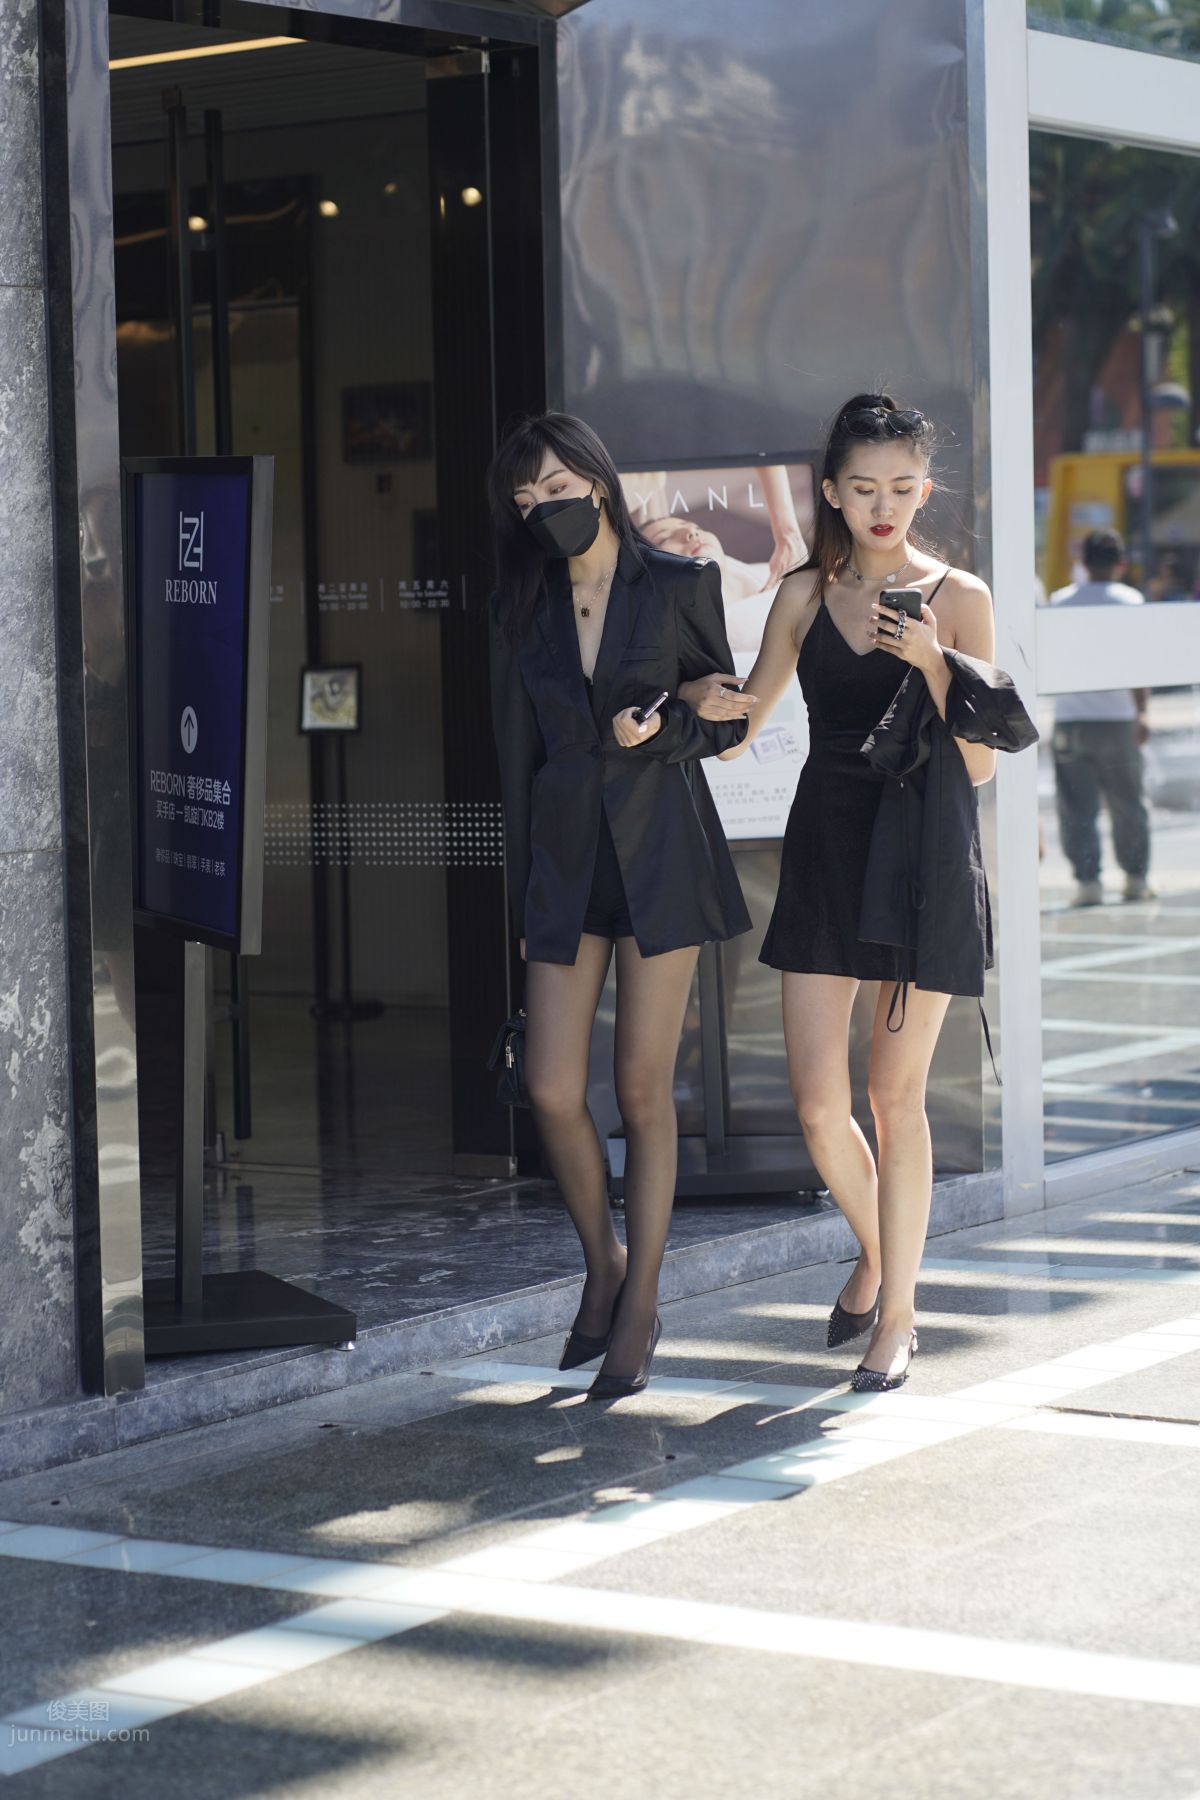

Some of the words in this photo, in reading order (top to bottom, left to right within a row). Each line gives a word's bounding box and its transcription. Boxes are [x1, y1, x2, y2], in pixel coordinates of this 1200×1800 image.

[165, 579, 217, 604] REBORN
[150, 770, 186, 797] REBORN
[186, 775, 232, 805] 奢侈品集合
